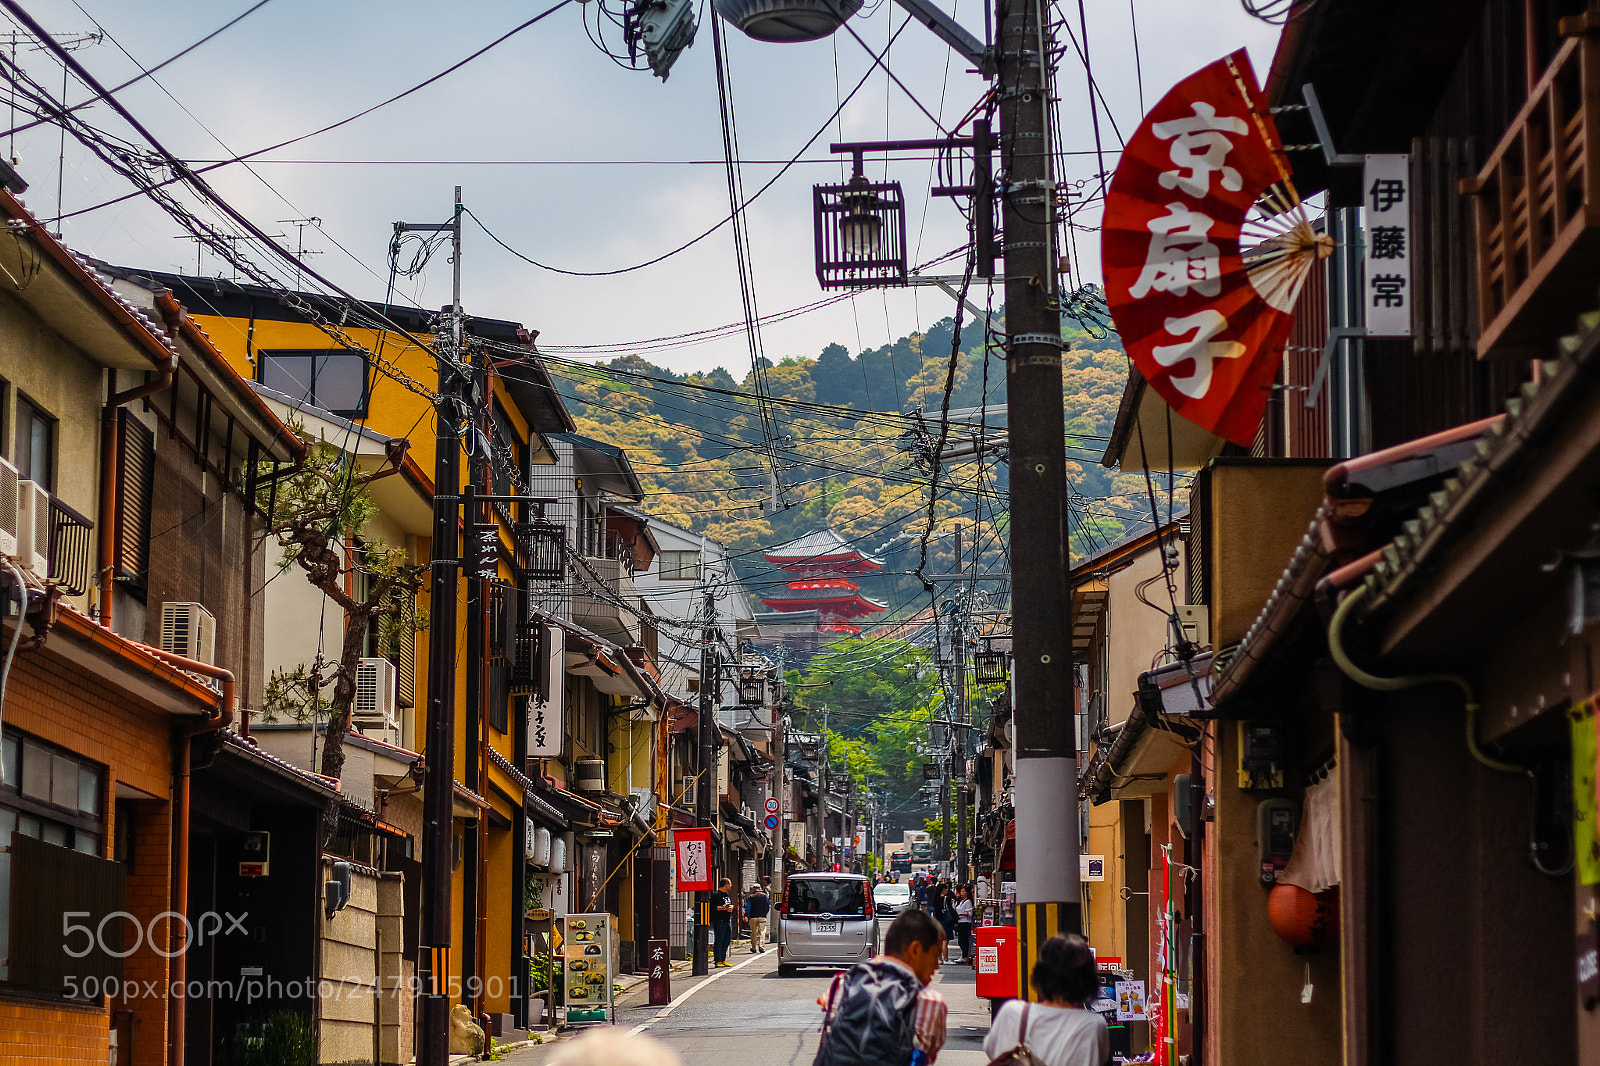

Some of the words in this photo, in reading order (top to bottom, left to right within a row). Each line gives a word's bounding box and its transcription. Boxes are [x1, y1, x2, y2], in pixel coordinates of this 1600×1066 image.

[1128, 102, 1249, 399] 京扇子
[1369, 178, 1406, 308] 伊藤常
[767, 801, 777, 810] 30
[686, 841, 699, 878] わらび餅
[651, 946, 664, 979] 茶房
